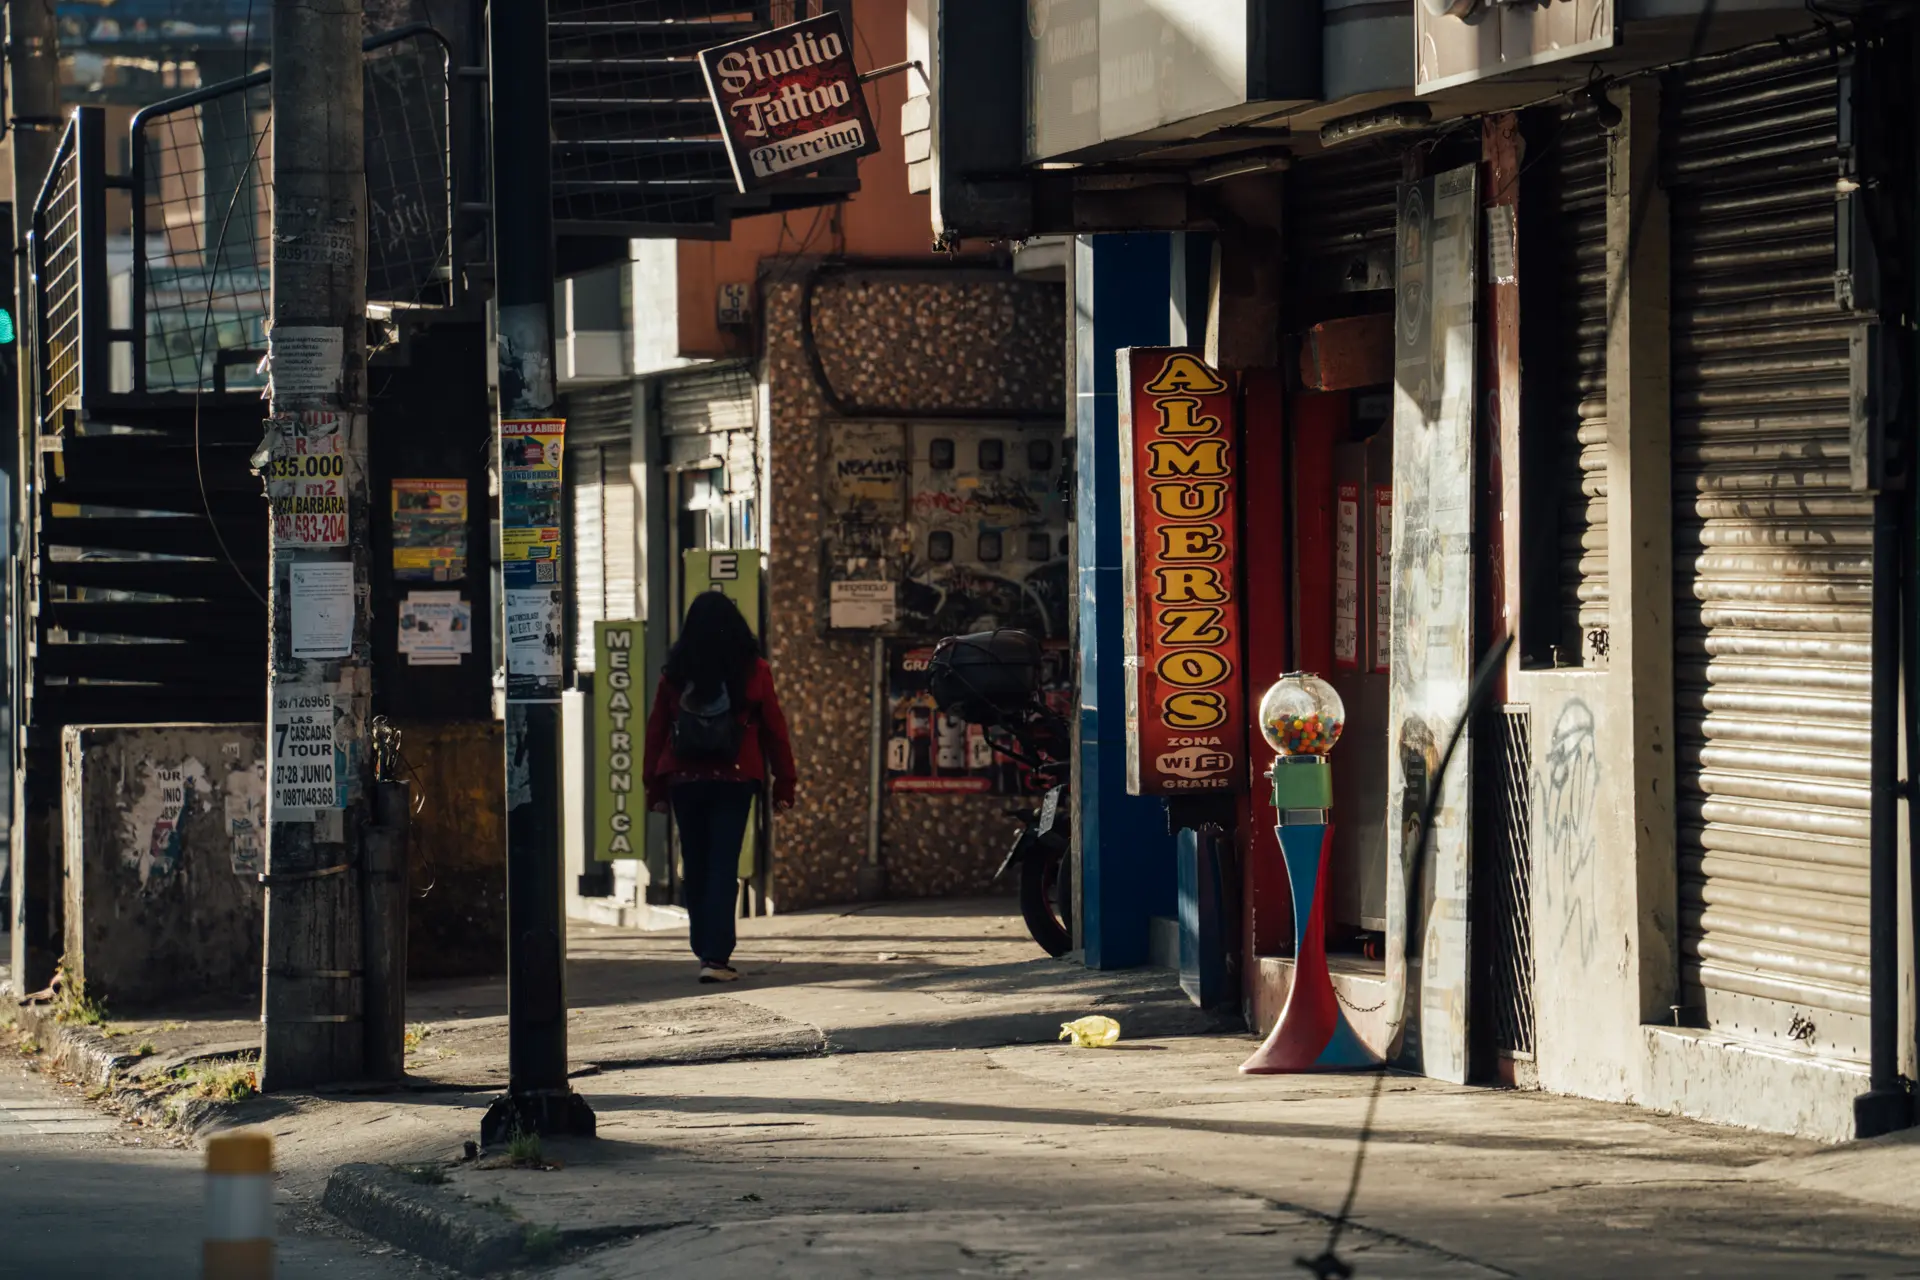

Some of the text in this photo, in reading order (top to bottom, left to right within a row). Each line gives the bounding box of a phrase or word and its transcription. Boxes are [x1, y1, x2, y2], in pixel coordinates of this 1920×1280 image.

[717, 32, 843, 97] Studio
[730, 80, 850, 138] Tattoo
[753, 127, 864, 173] Piercing
[297, 497, 345, 514] BARBARA
[1145, 353, 1232, 730] ALMUERZOS
[290, 716, 313, 724] LAS
[275, 724, 289, 758] 7
[290, 725, 331, 741] CASCADAS
[606, 630, 632, 853] MEGATRONICA
[1167, 737, 1221, 746] ZONA
[289, 745, 332, 757] TOUR
[276, 764, 332, 784] 27-28 JUNIO
[1162, 779, 1229, 788] GRATIS
[282, 787, 334, 806] 0987048368
